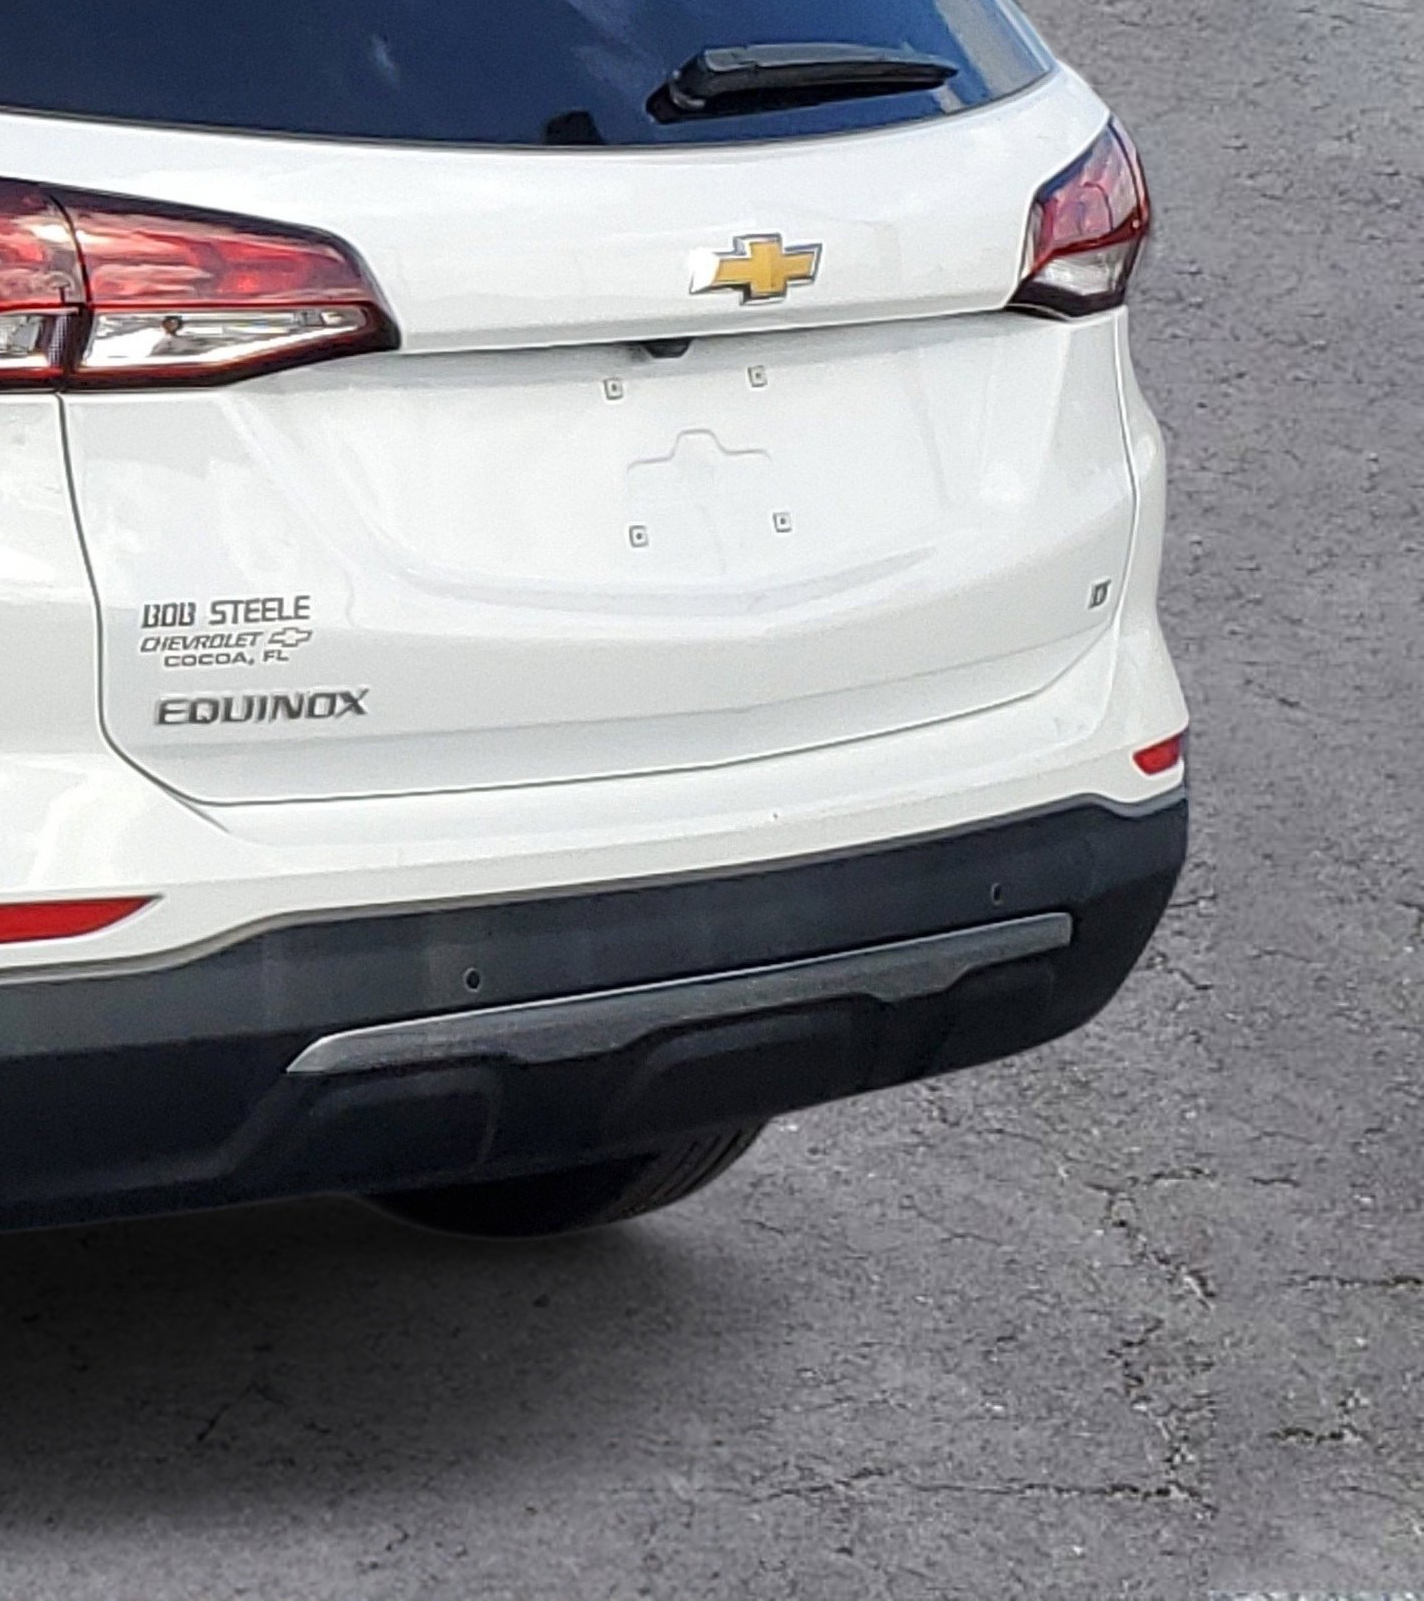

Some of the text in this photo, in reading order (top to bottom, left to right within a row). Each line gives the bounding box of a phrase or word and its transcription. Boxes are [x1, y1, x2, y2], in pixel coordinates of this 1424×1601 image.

[140, 595, 311, 629] BOB STEELE
[140, 630, 264, 653] CHEVROLET
[163, 649, 290, 667] COCOA, FL
[156, 687, 370, 726] EQUINOX
